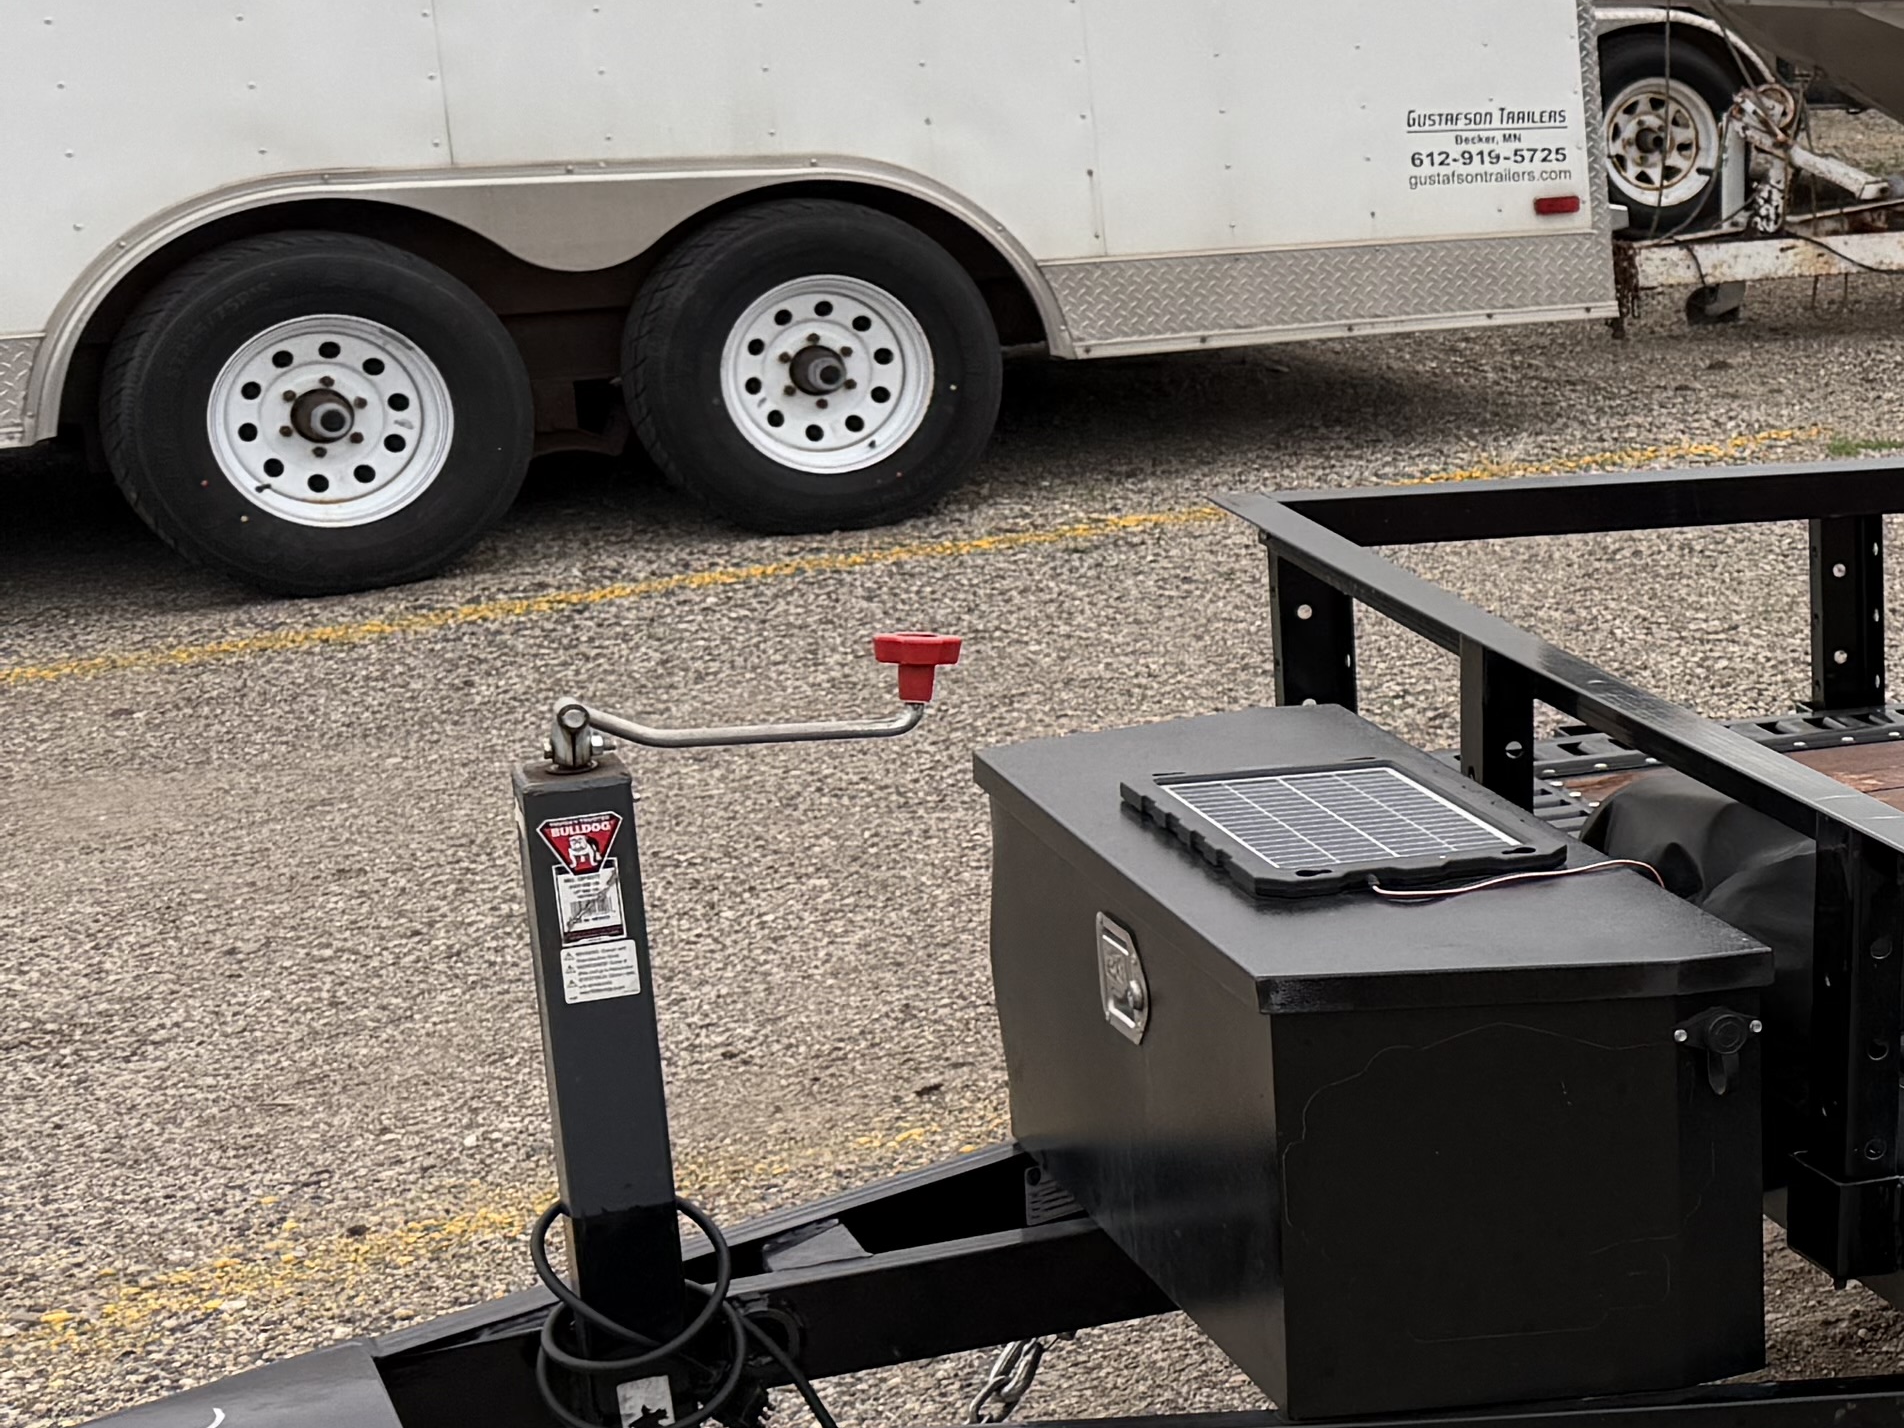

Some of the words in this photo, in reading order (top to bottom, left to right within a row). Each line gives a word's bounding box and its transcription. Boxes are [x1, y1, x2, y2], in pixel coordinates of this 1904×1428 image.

[1455, 134, 1499, 146] Becker,
[1503, 133, 1521, 144] MN
[1411, 147, 1567, 168] 612-919-5725
[1408, 168, 1571, 189] gustafsontrailers.com
[551, 821, 611, 838] BULLDOG
